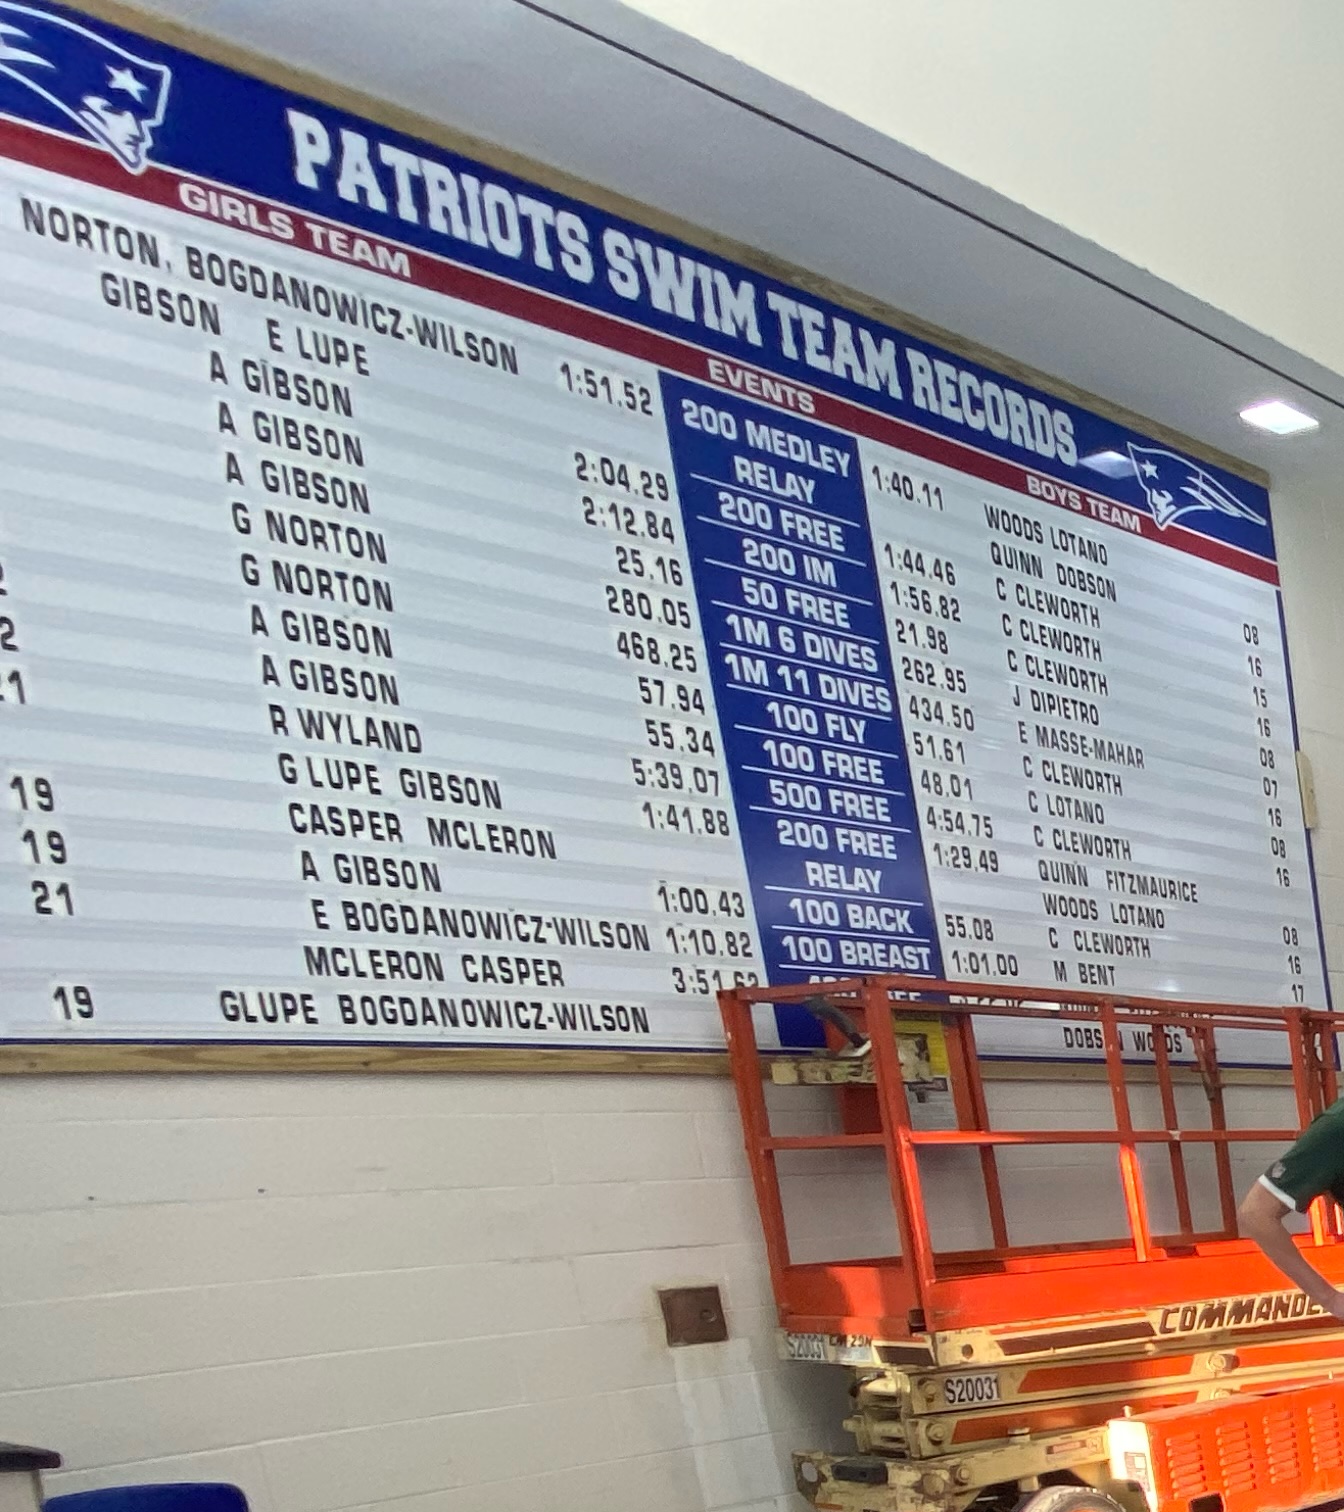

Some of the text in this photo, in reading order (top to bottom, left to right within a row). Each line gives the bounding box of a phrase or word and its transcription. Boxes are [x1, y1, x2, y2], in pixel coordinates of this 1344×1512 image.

[179, 182, 411, 278] GIRLS TEAM
[287, 108, 1079, 466] PATRIOTS SWIM TEAM RECORDS
[101, 272, 369, 376] GIBSON E LUPE
[186, 246, 518, 375] BOGDANOWICZ-WILSON
[210, 350, 352, 418] A GIBSON
[560, 362, 653, 416] 1:51.52
[708, 358, 816, 414] EVENTS
[219, 401, 364, 467] A GIBSON
[681, 399, 850, 477] 200 MEDLEY
[226, 451, 370, 514] A GIBSON
[574, 452, 669, 501] 2:04.29
[734, 455, 815, 504] RELAY
[872, 465, 943, 511] 1:40.11
[582, 496, 674, 545] 2:12.84
[718, 491, 845, 552] 200 FREE
[1026, 475, 1142, 532] BOYS TEAM
[231, 502, 388, 564] G NORTON
[984, 503, 1108, 566] WOODS LOTANO
[241, 553, 393, 612] G NORTON
[616, 546, 683, 586] 25.16
[742, 538, 837, 587] 200 IM
[884, 543, 956, 586] 1:44.46
[990, 541, 1117, 602] QUINN DOBSON
[606, 585, 691, 629] 280.05
[741, 576, 850, 628] 50 FREE
[890, 581, 961, 623] 1:56.82
[996, 577, 1100, 629] C CLEWORTH
[251, 604, 393, 659] A GIBSON
[617, 631, 697, 673] 468.25
[726, 614, 878, 673] 1M 6 DIVES
[895, 618, 948, 655] 21.98
[1002, 613, 1102, 662] C CLEWORTH
[1243, 623, 1259, 645] 08
[262, 654, 400, 706] A GIBSON
[725, 653, 893, 713] 1M 11 DIVES
[901, 656, 967, 693] 262.95
[1007, 649, 1108, 696] C CLEWORTH
[1248, 655, 1262, 677] 16
[638, 676, 705, 716] 57.94
[909, 695, 975, 731] 434.50
[1013, 685, 1100, 726] J DIPIETRO
[268, 703, 422, 753] R WYLAND
[645, 719, 715, 757] 55.34
[767, 702, 867, 744] 100 FLY
[1257, 717, 1271, 737] 16
[762, 739, 885, 785] 100 FREE
[913, 731, 965, 765] 51.61
[1018, 721, 1145, 769] E MASSE-MAHAR
[10, 775, 54, 812] 19
[278, 752, 502, 810] G LUPE GIBSON
[631, 758, 719, 796] 5:39.07
[921, 769, 973, 801] 48.01
[1023, 755, 1123, 796] C CLEWORTH
[642, 801, 730, 836] 1:41.88
[769, 779, 891, 823] 500 FREE
[926, 806, 993, 838] 4:54.75
[1028, 790, 1105, 825] C LOTANO
[1268, 808, 1282, 827] 16
[22, 829, 68, 865] 19
[288, 802, 557, 860] CASPER MCLERON
[777, 819, 897, 861] 200 FREE
[1033, 825, 1132, 862] C CLEWORTH
[301, 850, 442, 893] A GIBSON
[805, 861, 882, 894] RELAY
[933, 843, 999, 873] 1:29.49
[1276, 867, 1290, 887] 16
[31, 880, 74, 916] 21
[658, 886, 745, 918] 1:00.43
[1038, 859, 1198, 903] QUINN FITZMAURICE
[310, 899, 650, 951] E BOGDANOWICZ-WILSON
[789, 898, 914, 934] 100 BACK
[945, 914, 994, 941] 55.08
[1042, 893, 1165, 928] WOODS LOTANO
[666, 928, 752, 958] 1:10.82
[782, 936, 931, 971] 100 BREAST
[1048, 927, 1151, 958] C CLEWORTH
[1283, 926, 1298, 946] 08
[303, 945, 565, 987] MCLERON CASPER
[952, 950, 1018, 976] 1:01.00
[1053, 960, 1115, 986] M BENT
[1288, 955, 1302, 974] 16
[52, 985, 95, 1021] 19
[337, 993, 650, 1033] BOGDANOWICZ-WILSON
[945, 1377, 999, 1404] S20031
